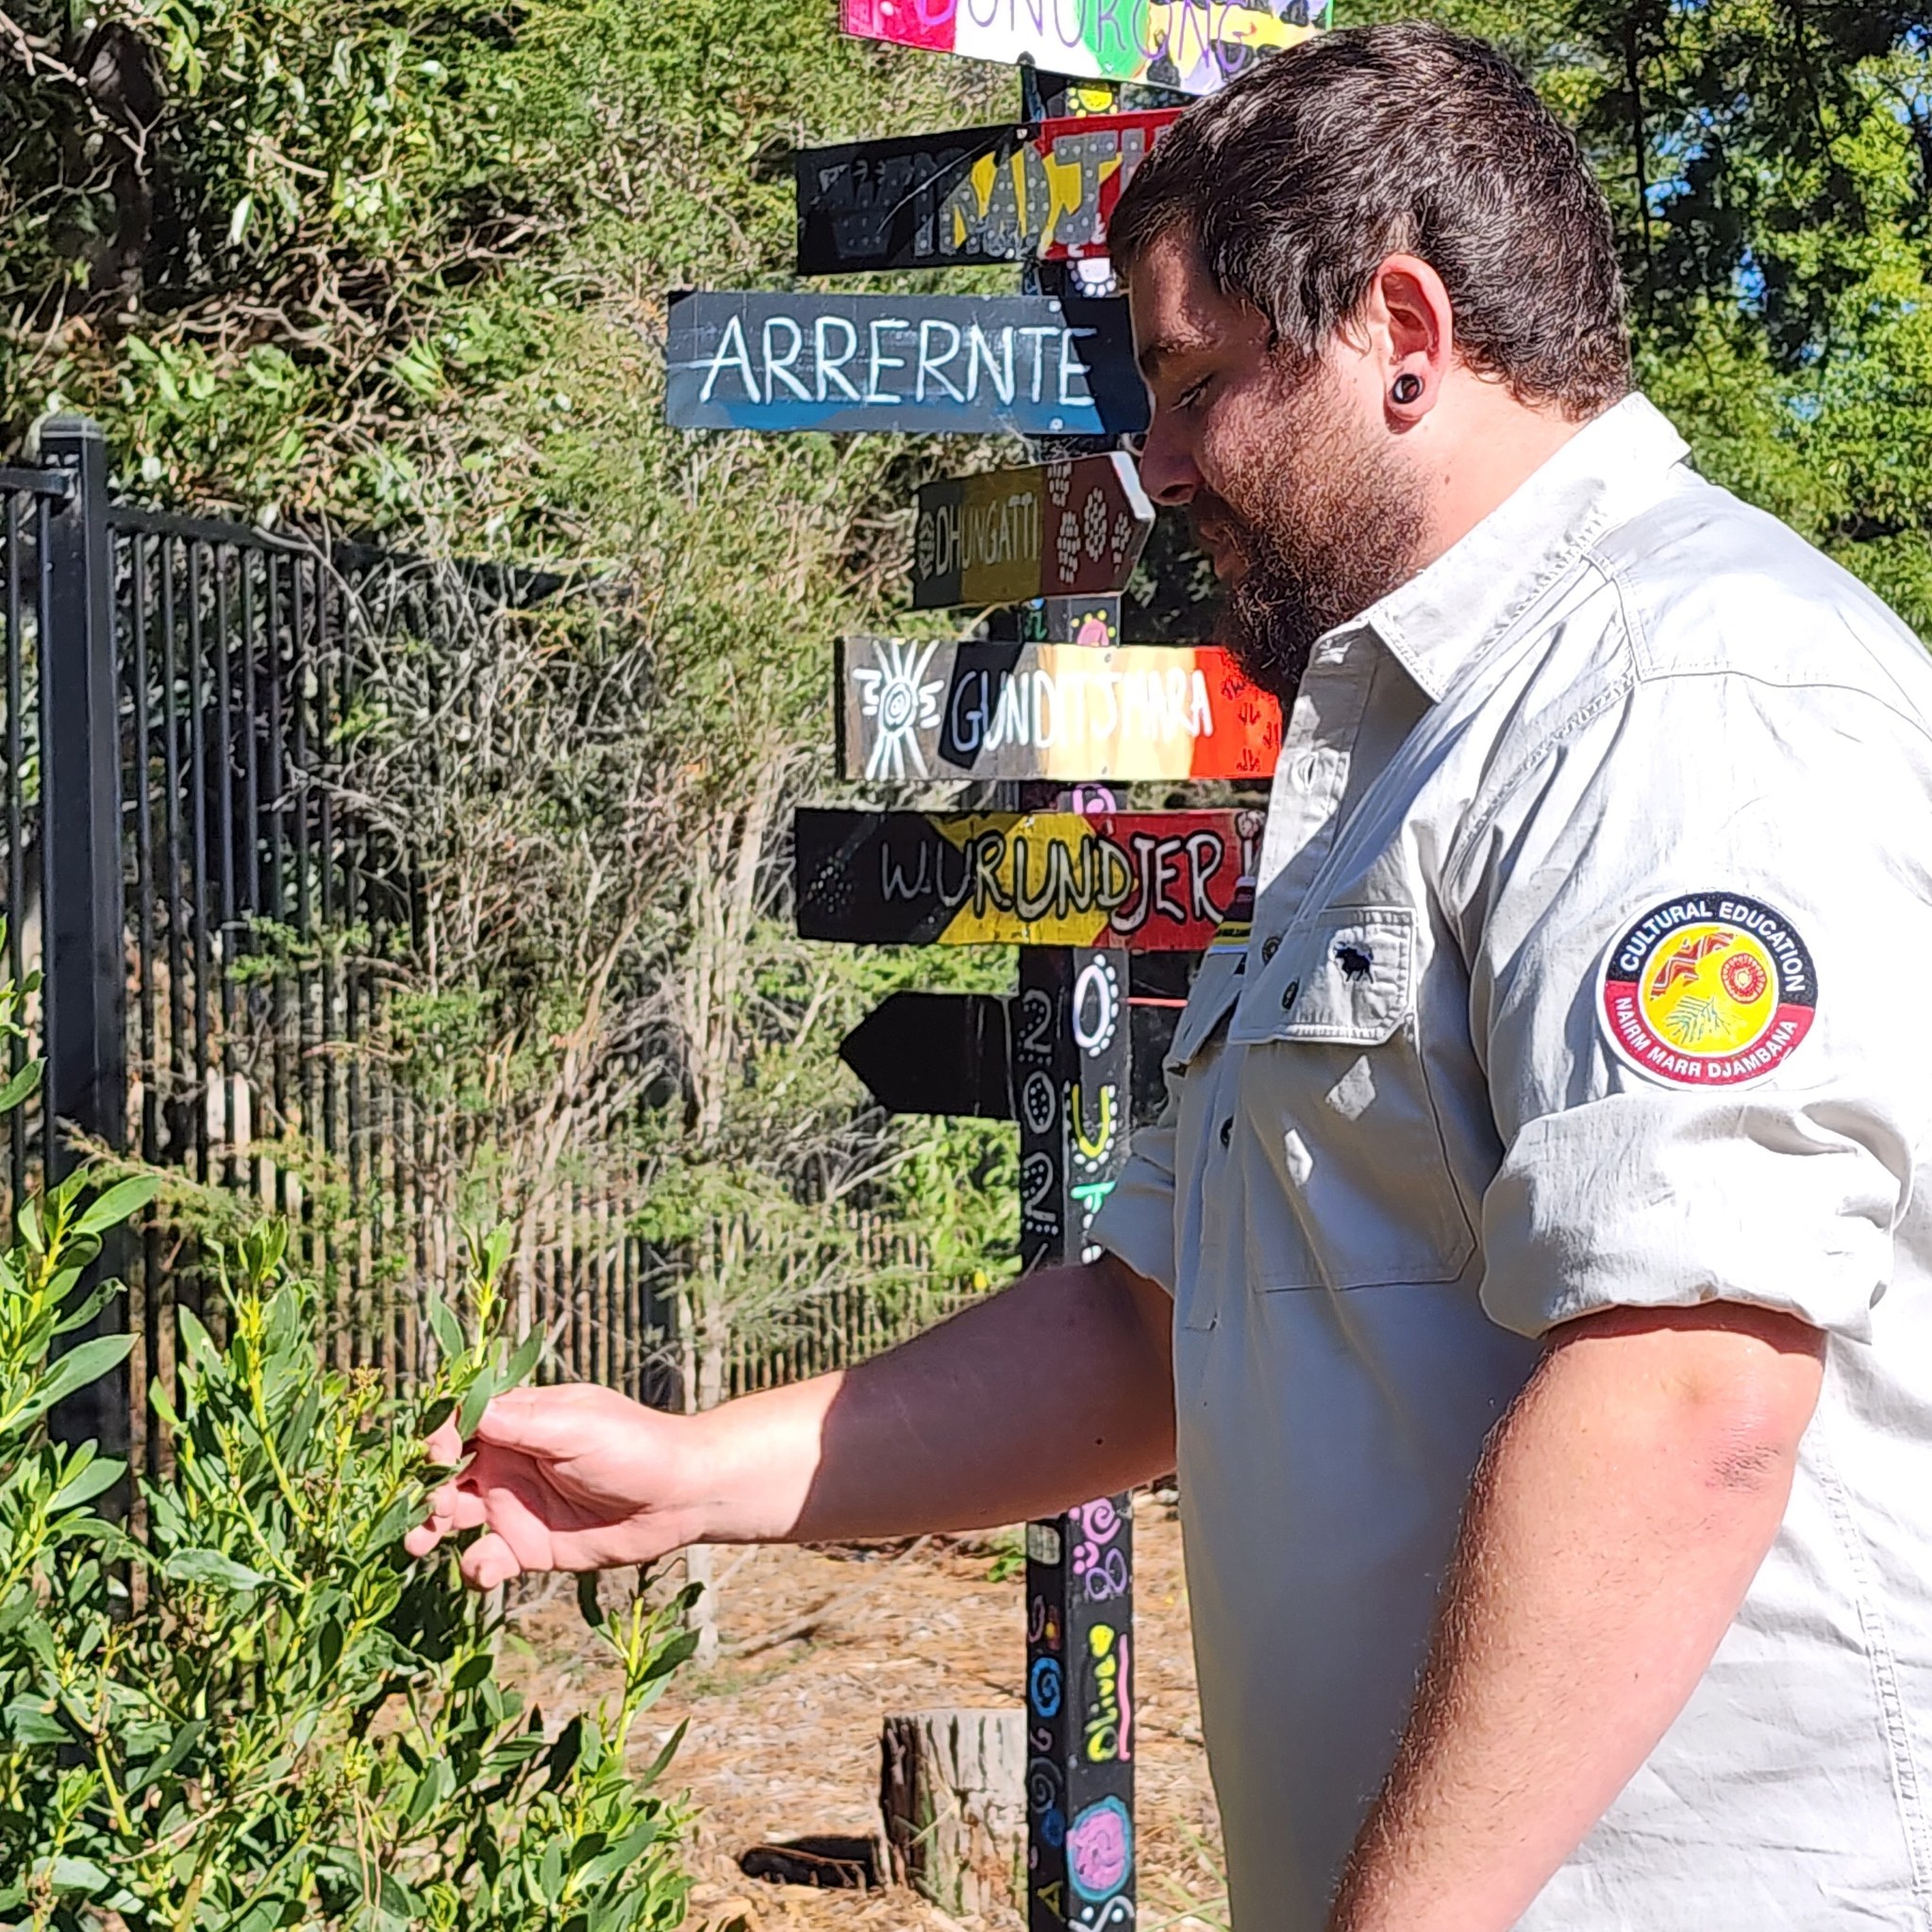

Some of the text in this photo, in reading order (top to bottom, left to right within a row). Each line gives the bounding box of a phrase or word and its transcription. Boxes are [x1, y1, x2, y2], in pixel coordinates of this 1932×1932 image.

[685, 315, 1097, 407] ARRERNTE
[936, 491, 1038, 576] DHUNGATTI
[1619, 900, 1806, 992] CULTURAL EDUCATION
[1615, 996, 1799, 1078] NAIRM MARR DJAMBANA
